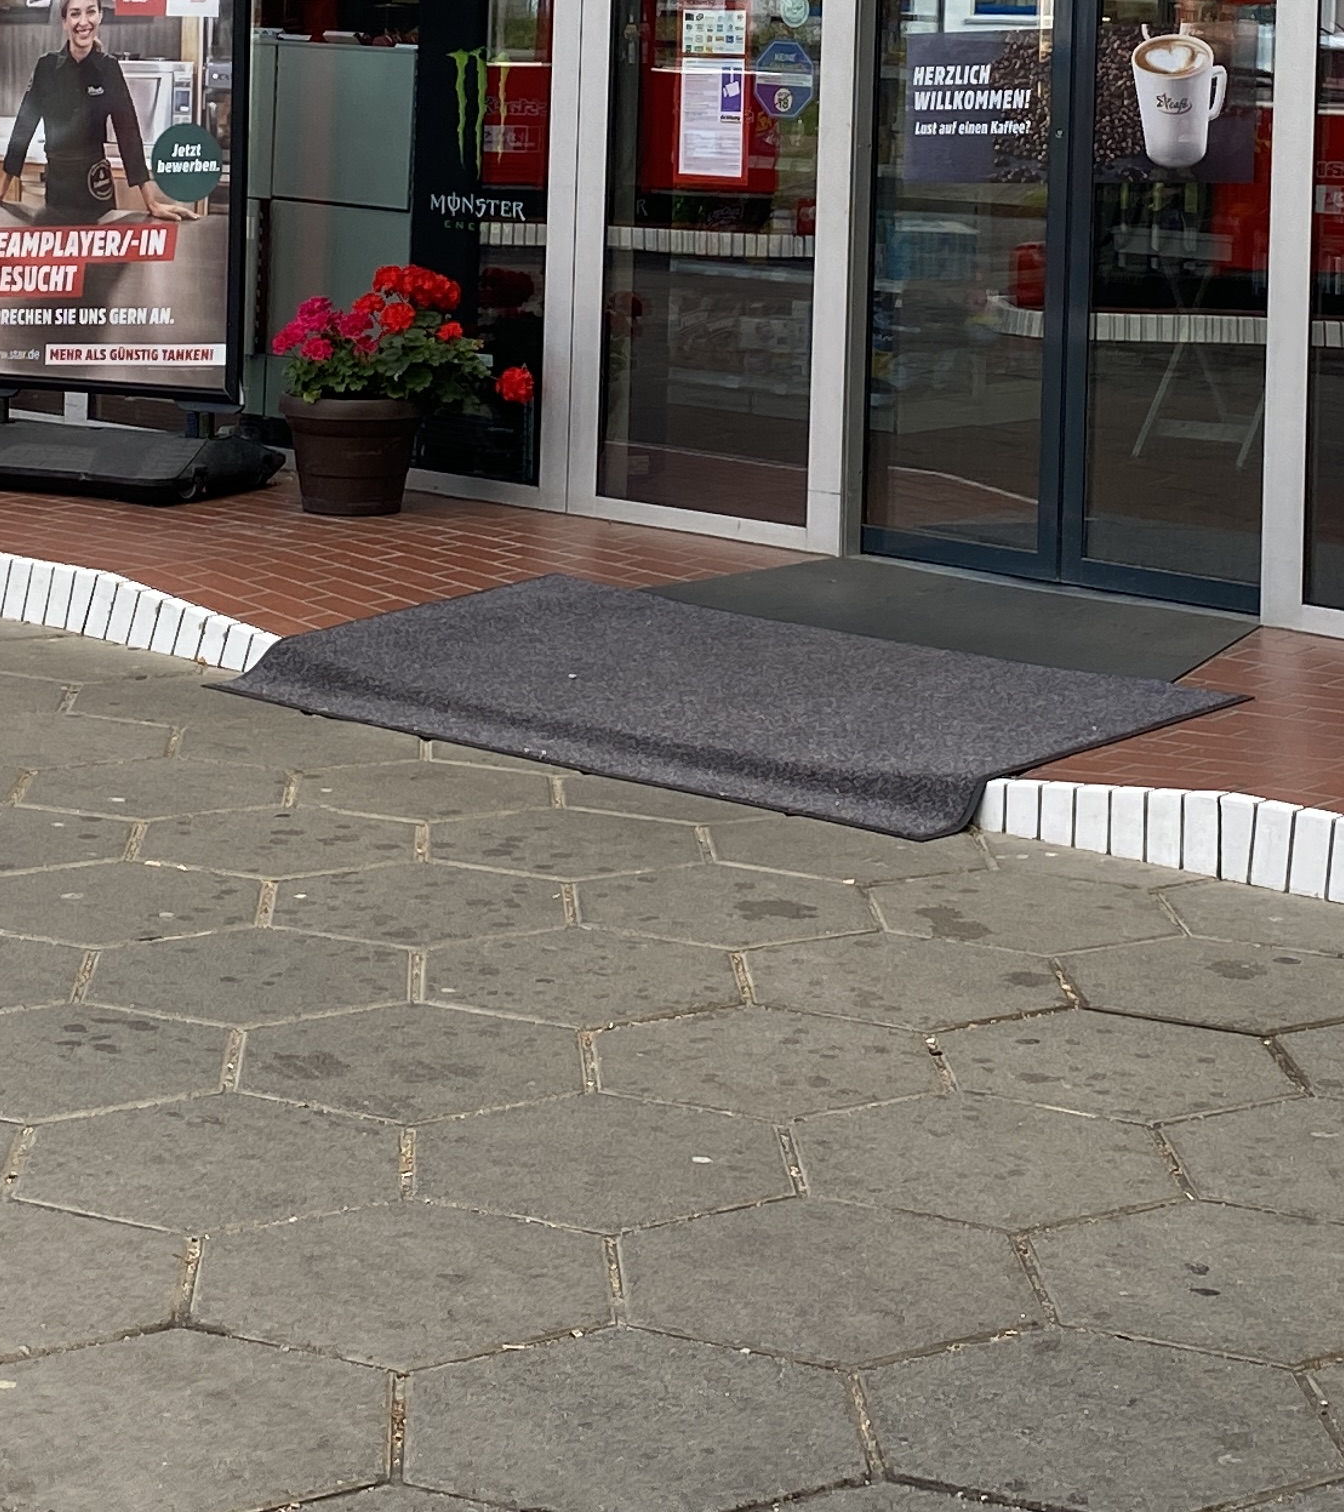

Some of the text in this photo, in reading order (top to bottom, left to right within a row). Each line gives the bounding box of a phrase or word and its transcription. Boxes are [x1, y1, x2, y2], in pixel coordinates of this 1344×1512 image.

[913, 64, 991, 86] HERZLICH
[913, 89, 1031, 110] WILLKOMMEN!
[914, 119, 1031, 136] Lust auf einen Kaffee?
[172, 143, 202, 157] Jetzt
[157, 158, 221, 174] bewerben.
[54, 308, 77, 325] SIE
[79, 307, 107, 325] UNS
[109, 307, 148, 325] GERN
[149, 307, 175, 325] AN.
[50, 348, 83, 361] MEHR
[85, 348, 107, 361] ALS
[109, 347, 158, 362] GÜNSTIG
[162, 348, 214, 361] TANKEN!
